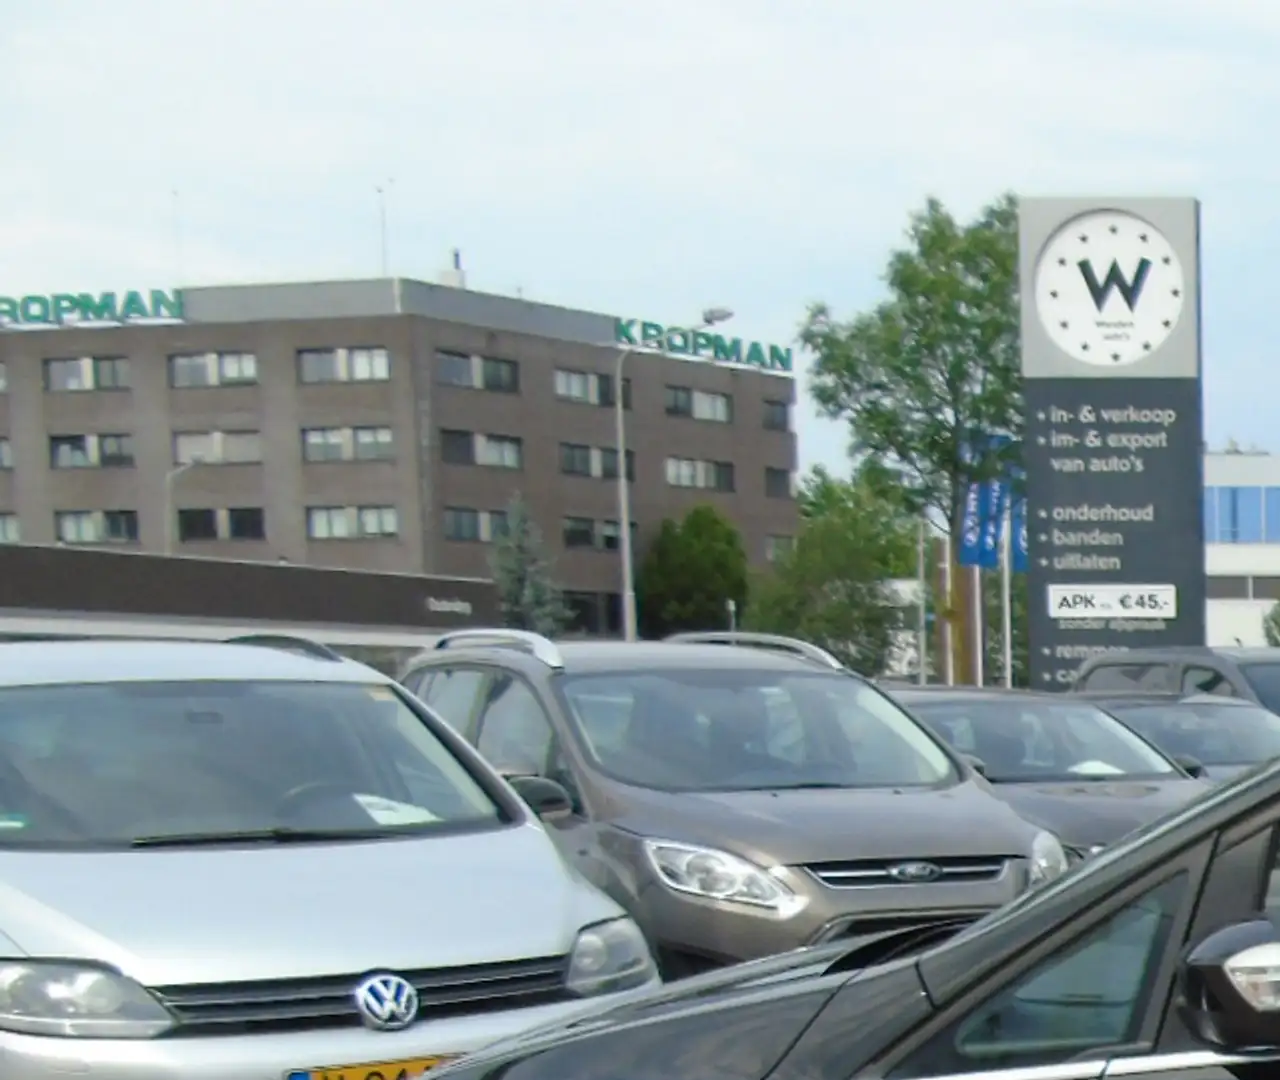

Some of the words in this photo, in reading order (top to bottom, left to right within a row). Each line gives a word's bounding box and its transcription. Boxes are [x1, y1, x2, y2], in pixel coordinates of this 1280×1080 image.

[614, 316, 793, 372] KROPMAN
[1049, 404, 1075, 424] in-
[1078, 404, 1097, 424] &
[1100, 404, 1177, 427] verkoop
[1049, 429, 1080, 449] im-
[1084, 429, 1103, 448] &
[1106, 431, 1168, 452] export
[1049, 457, 1085, 472] van
[1088, 454, 1144, 472] auto's
[1052, 503, 1154, 521] onderhoud
[1053, 528, 1124, 546] banden
[1058, 593, 1096, 609] APK
